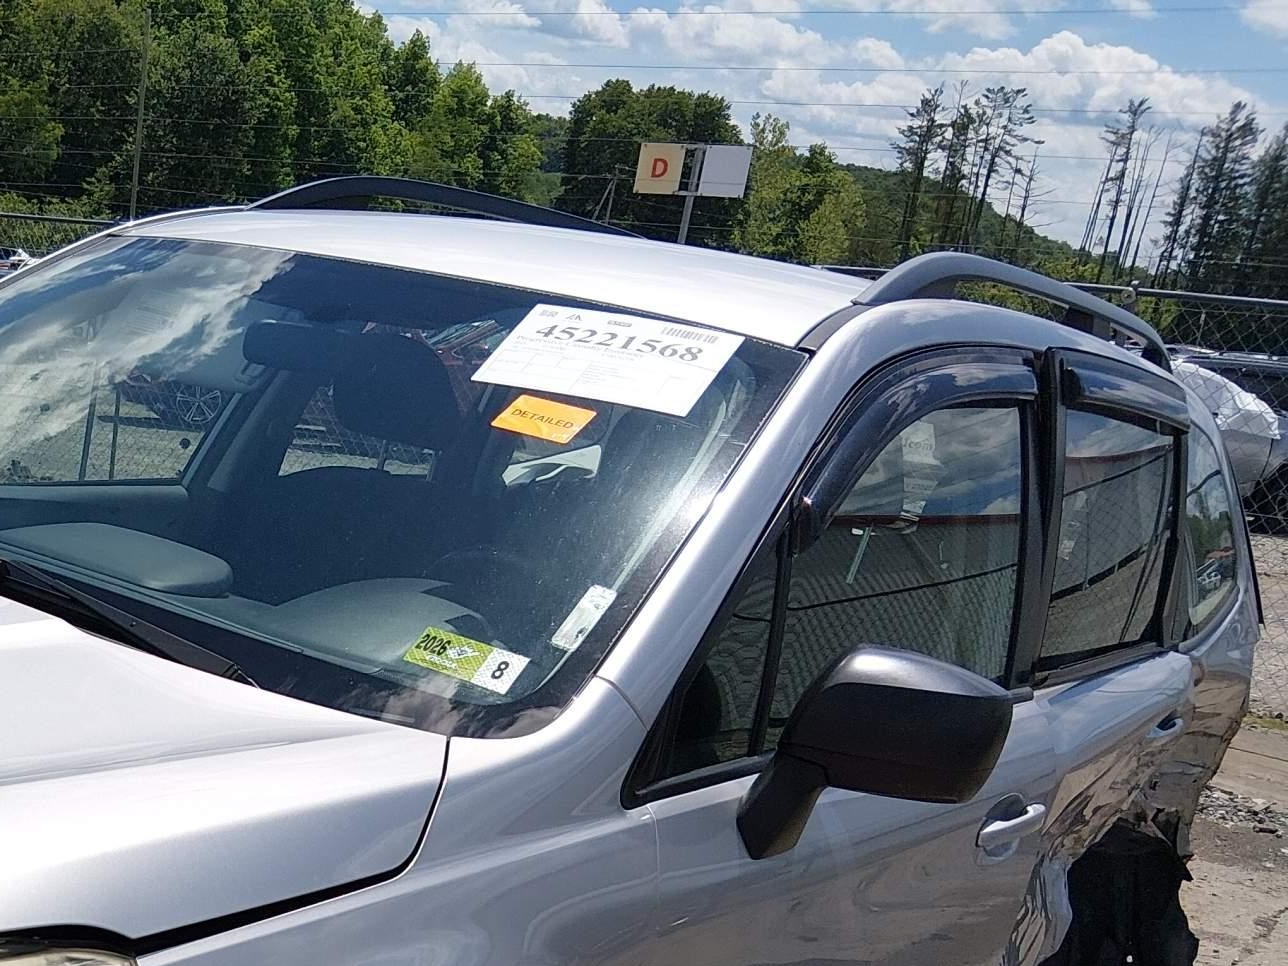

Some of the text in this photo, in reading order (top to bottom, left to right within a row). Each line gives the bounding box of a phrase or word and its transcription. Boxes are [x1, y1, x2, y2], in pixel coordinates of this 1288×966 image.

[651, 158, 668, 178] D
[535, 324, 703, 362] 45221568
[511, 408, 575, 429] DETAILED
[414, 633, 452, 656] 2026
[490, 660, 510, 680] 8
